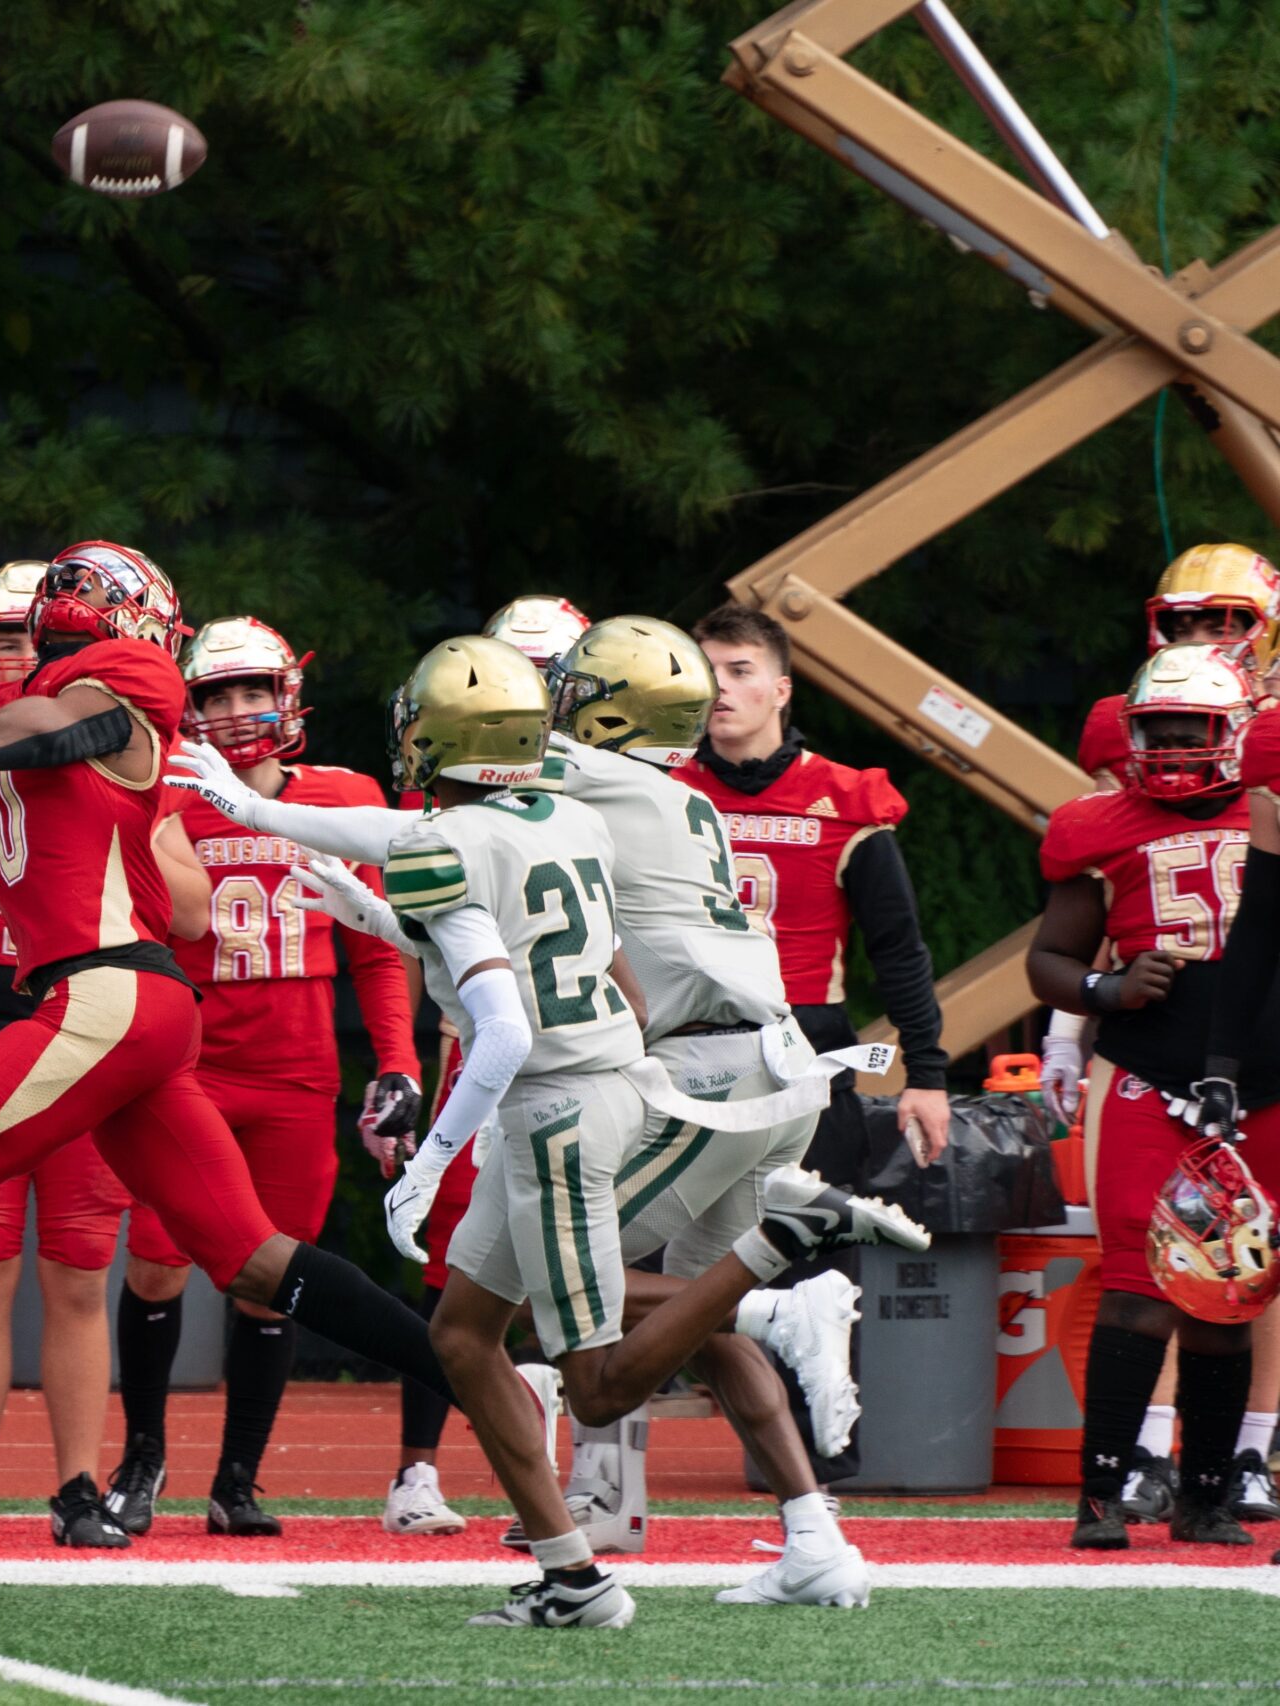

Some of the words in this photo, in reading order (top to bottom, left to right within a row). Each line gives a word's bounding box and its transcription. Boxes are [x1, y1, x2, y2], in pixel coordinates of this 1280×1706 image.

[478, 767, 541, 783] Riddell
[202, 789, 237, 815] STATE
[211, 876, 306, 982] 81
